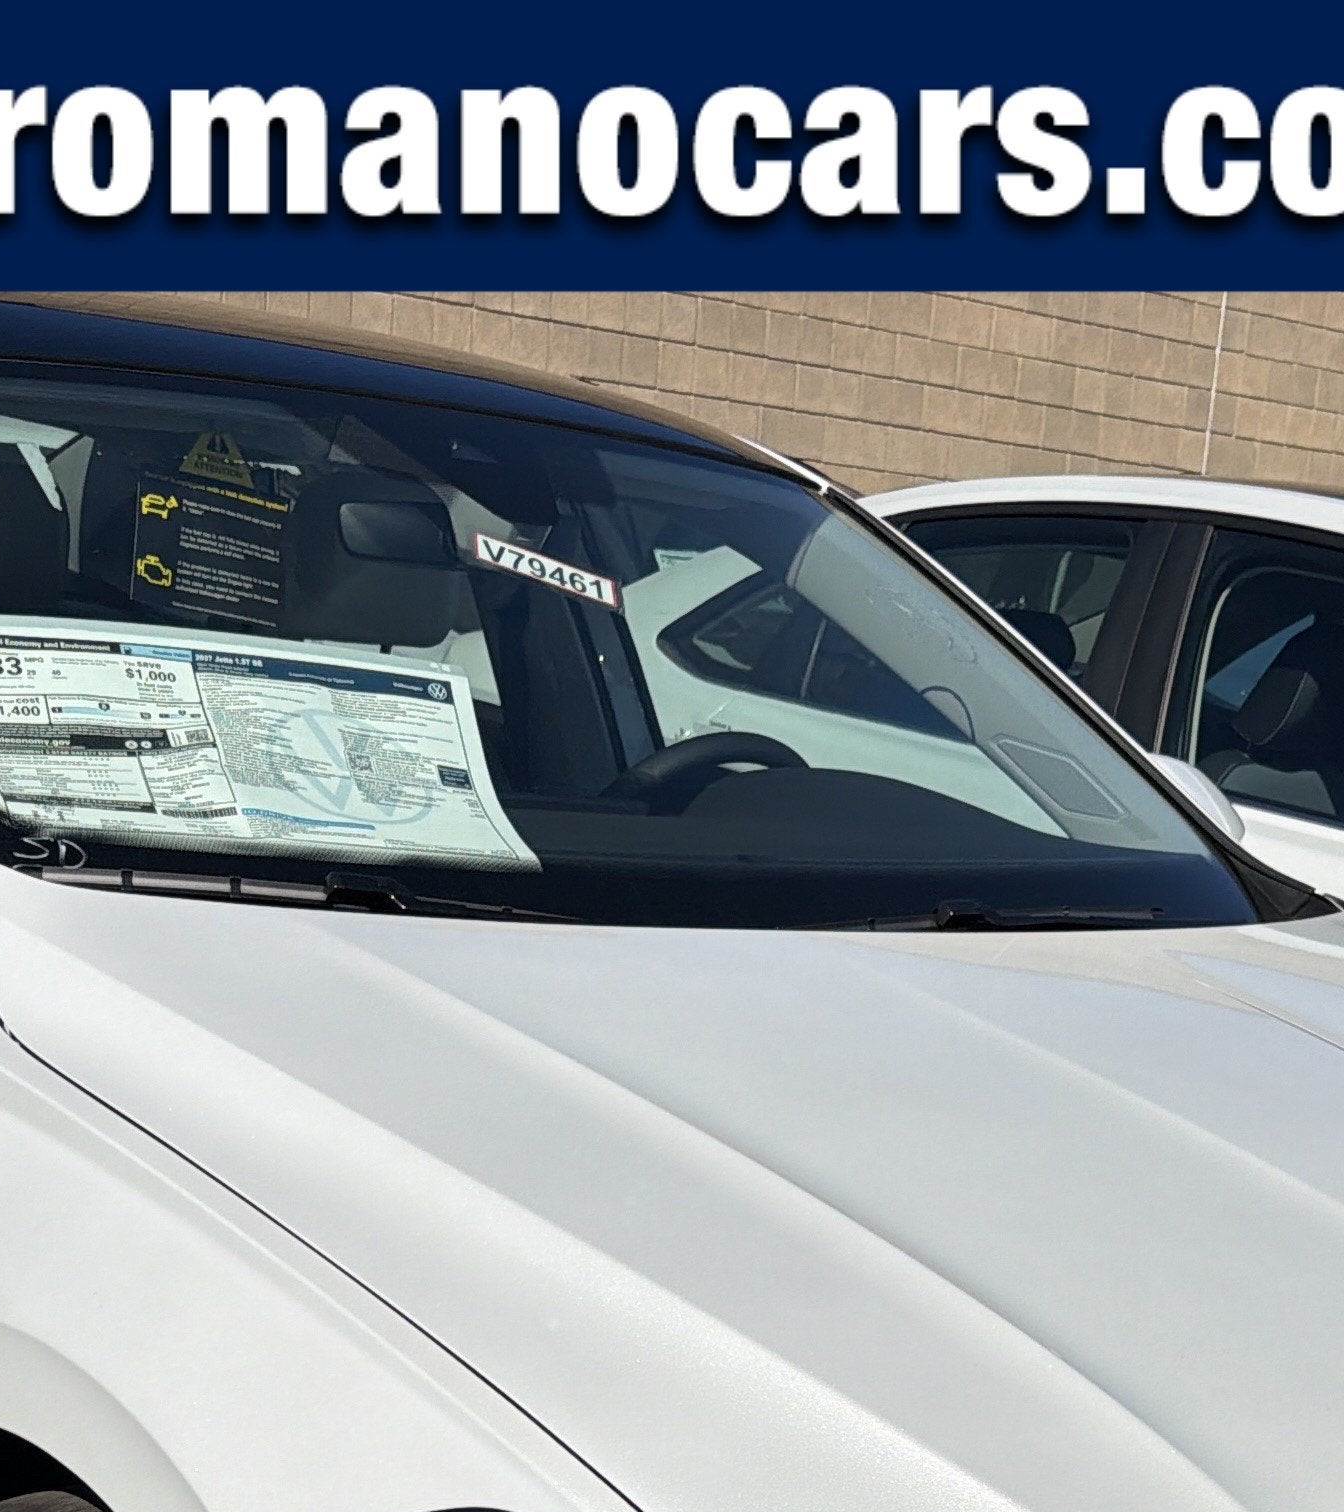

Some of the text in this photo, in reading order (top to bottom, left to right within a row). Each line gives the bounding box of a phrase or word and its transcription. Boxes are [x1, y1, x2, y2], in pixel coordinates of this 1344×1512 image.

[482, 539, 604, 600] V79461
[5, 638, 42, 649] Economy
[61, 642, 111, 652] Environment
[125, 668, 177, 683] $1,000
